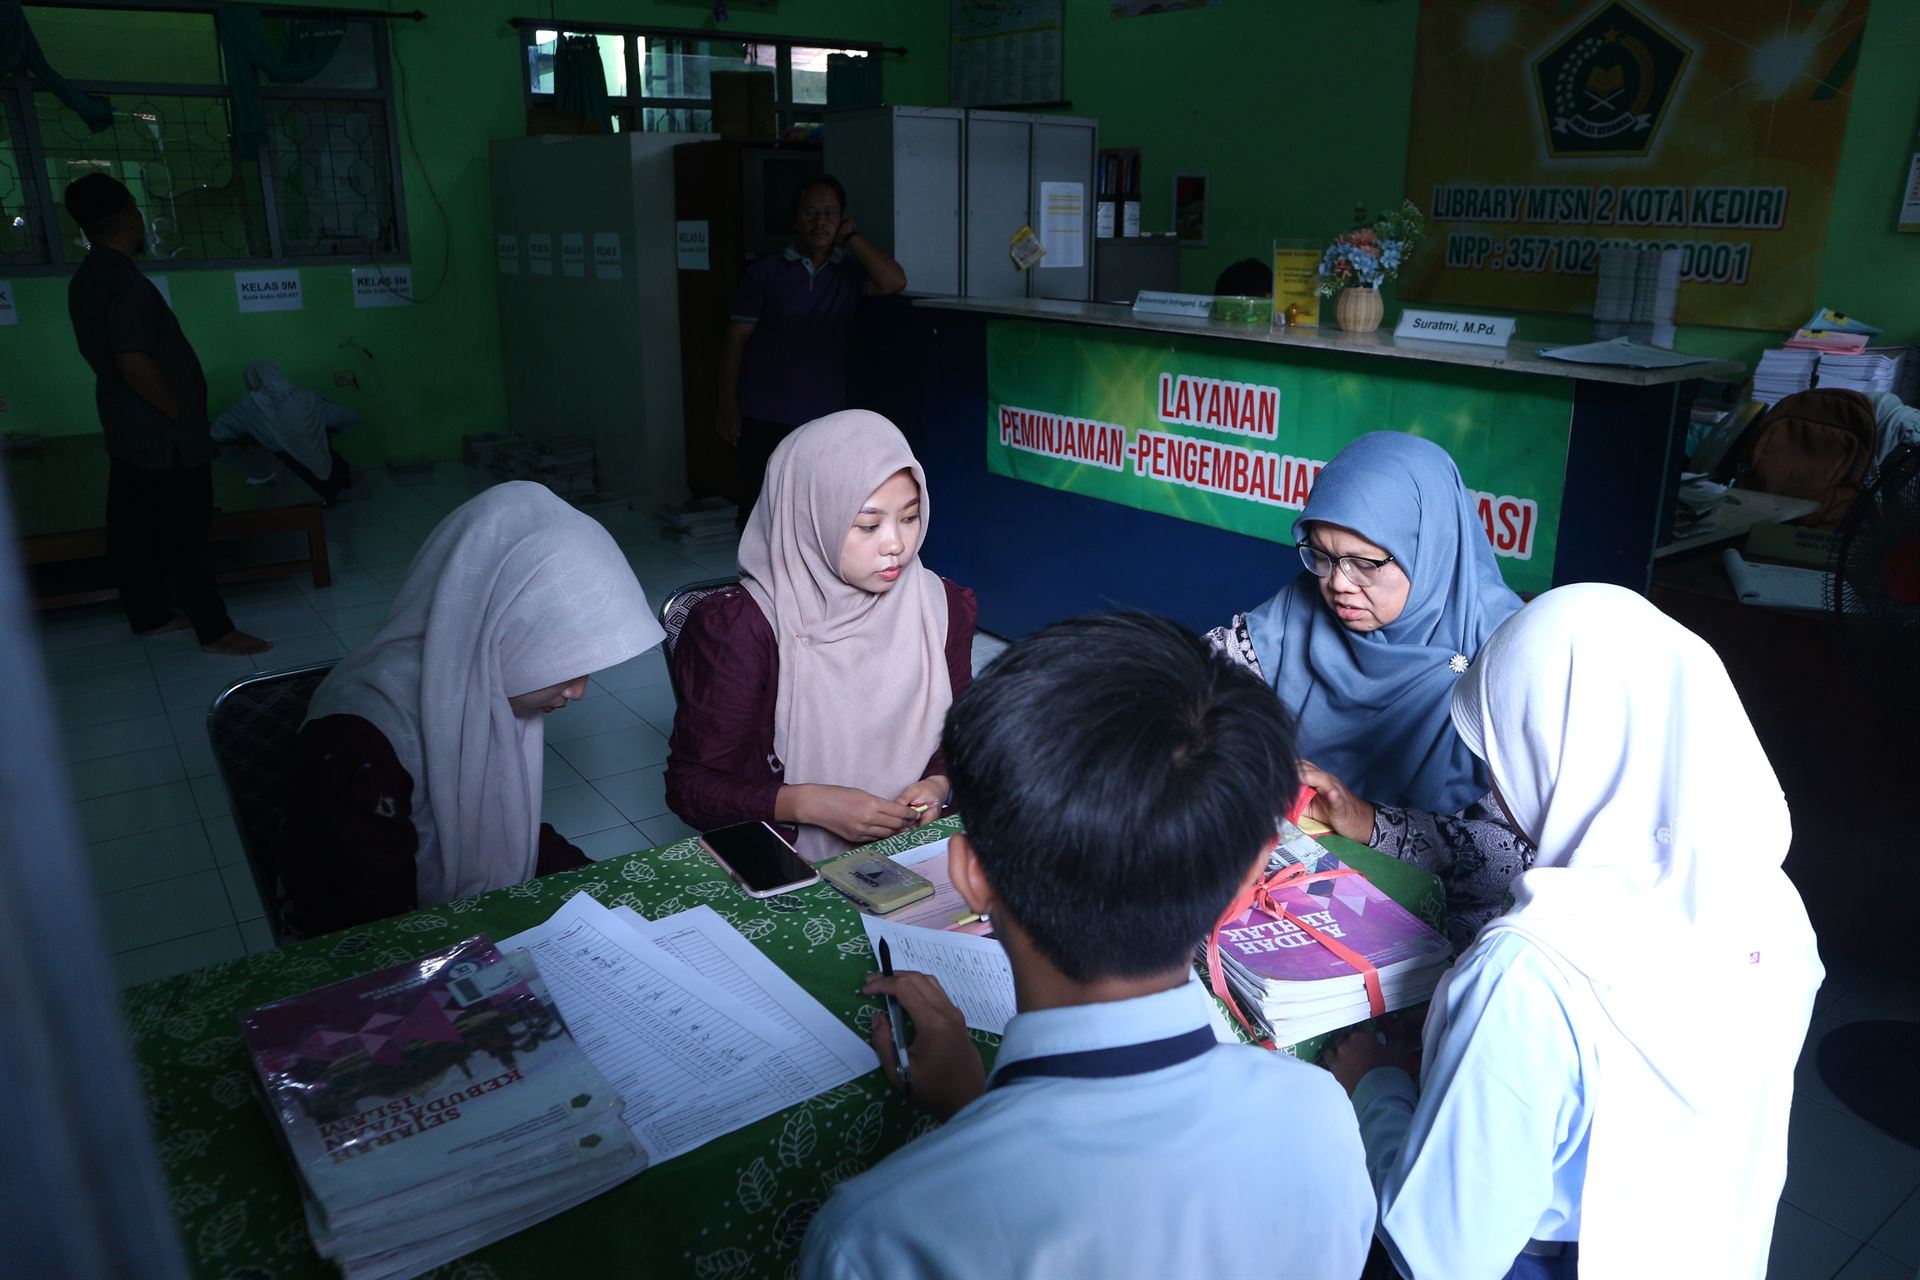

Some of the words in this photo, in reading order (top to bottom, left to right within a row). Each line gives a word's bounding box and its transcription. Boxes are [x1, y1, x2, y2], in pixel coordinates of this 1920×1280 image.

[1433, 188, 1522, 218] LIBRARY
[1527, 189, 1591, 220] MTSN
[1596, 189, 1613, 220] 2
[1619, 189, 1683, 222] KOTA
[1692, 190, 1785, 225] KEDIRI
[1449, 235, 1490, 265] NPP
[241, 281, 279, 292] KELAS
[281, 280, 297, 291] 9M
[357, 276, 392, 287] KELAS
[1412, 317, 1459, 334] Suratmi,
[1463, 321, 1496, 336] M.Pd.
[1162, 377, 1276, 435] LAYANAN
[1001, 407, 1123, 467] PEMINJAMAN
[1234, 922, 1347, 955] AIDAH
[318, 1095, 417, 1139] ISLAM
[324, 1068, 525, 1152] KEBUDAYAAN
[330, 1106, 462, 1164] SEJARAH
